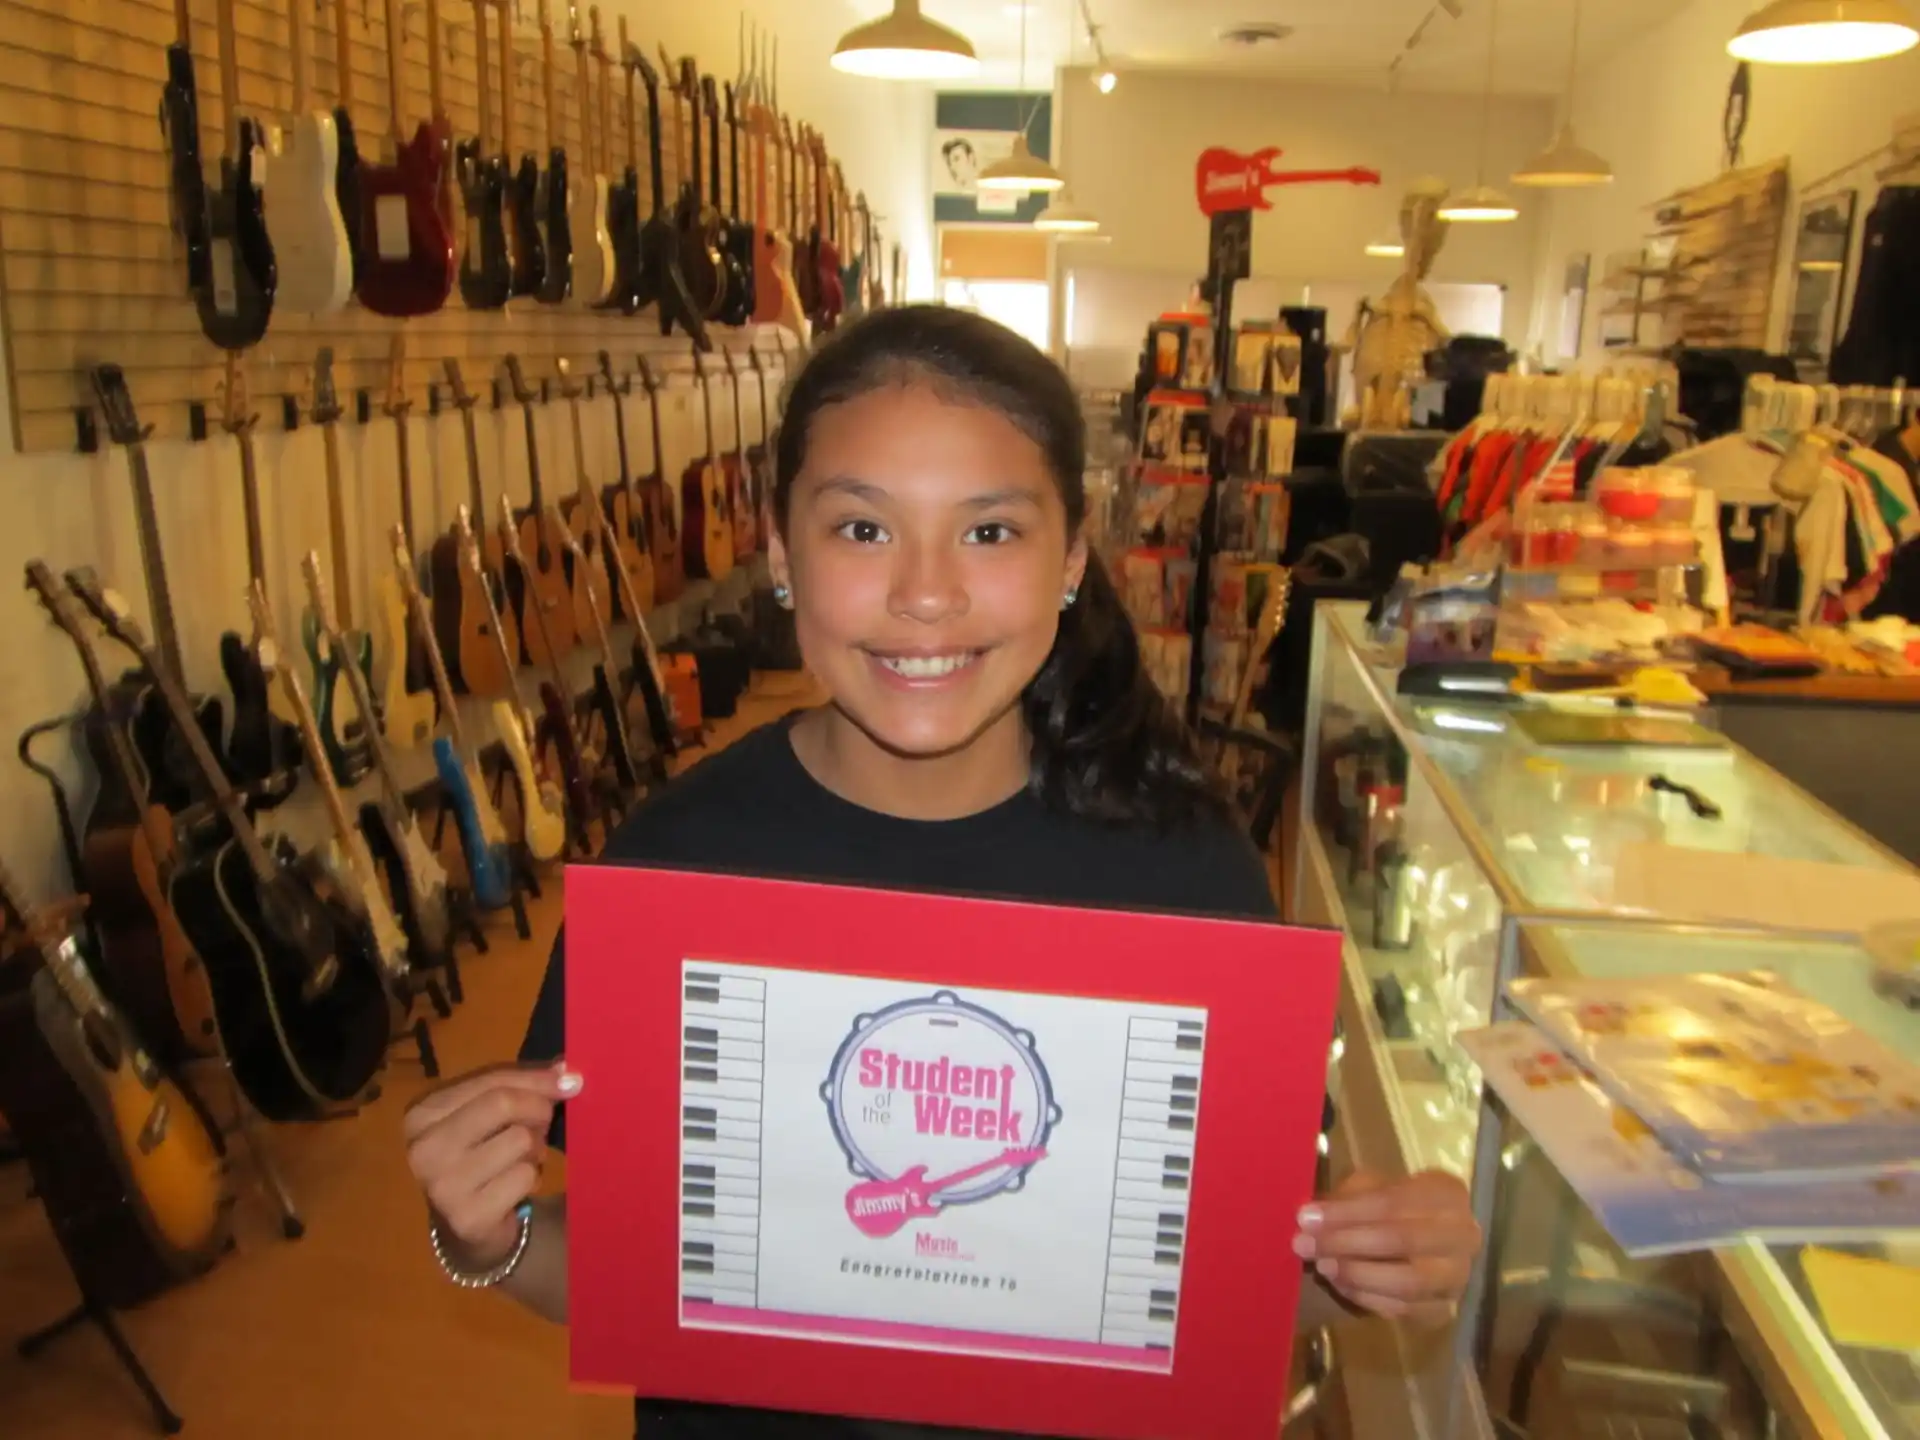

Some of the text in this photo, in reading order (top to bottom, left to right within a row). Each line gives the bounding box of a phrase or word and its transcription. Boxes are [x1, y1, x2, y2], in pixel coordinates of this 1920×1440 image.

[859, 1047, 1016, 1101] Student
[862, 1105, 892, 1125] the
[875, 1092, 891, 1109] of
[914, 1093, 1022, 1142] Week
[853, 1187, 921, 1217] Jimmy's
[840, 1257, 991, 1289] Congratulations
[999, 1276, 1018, 1292] to
